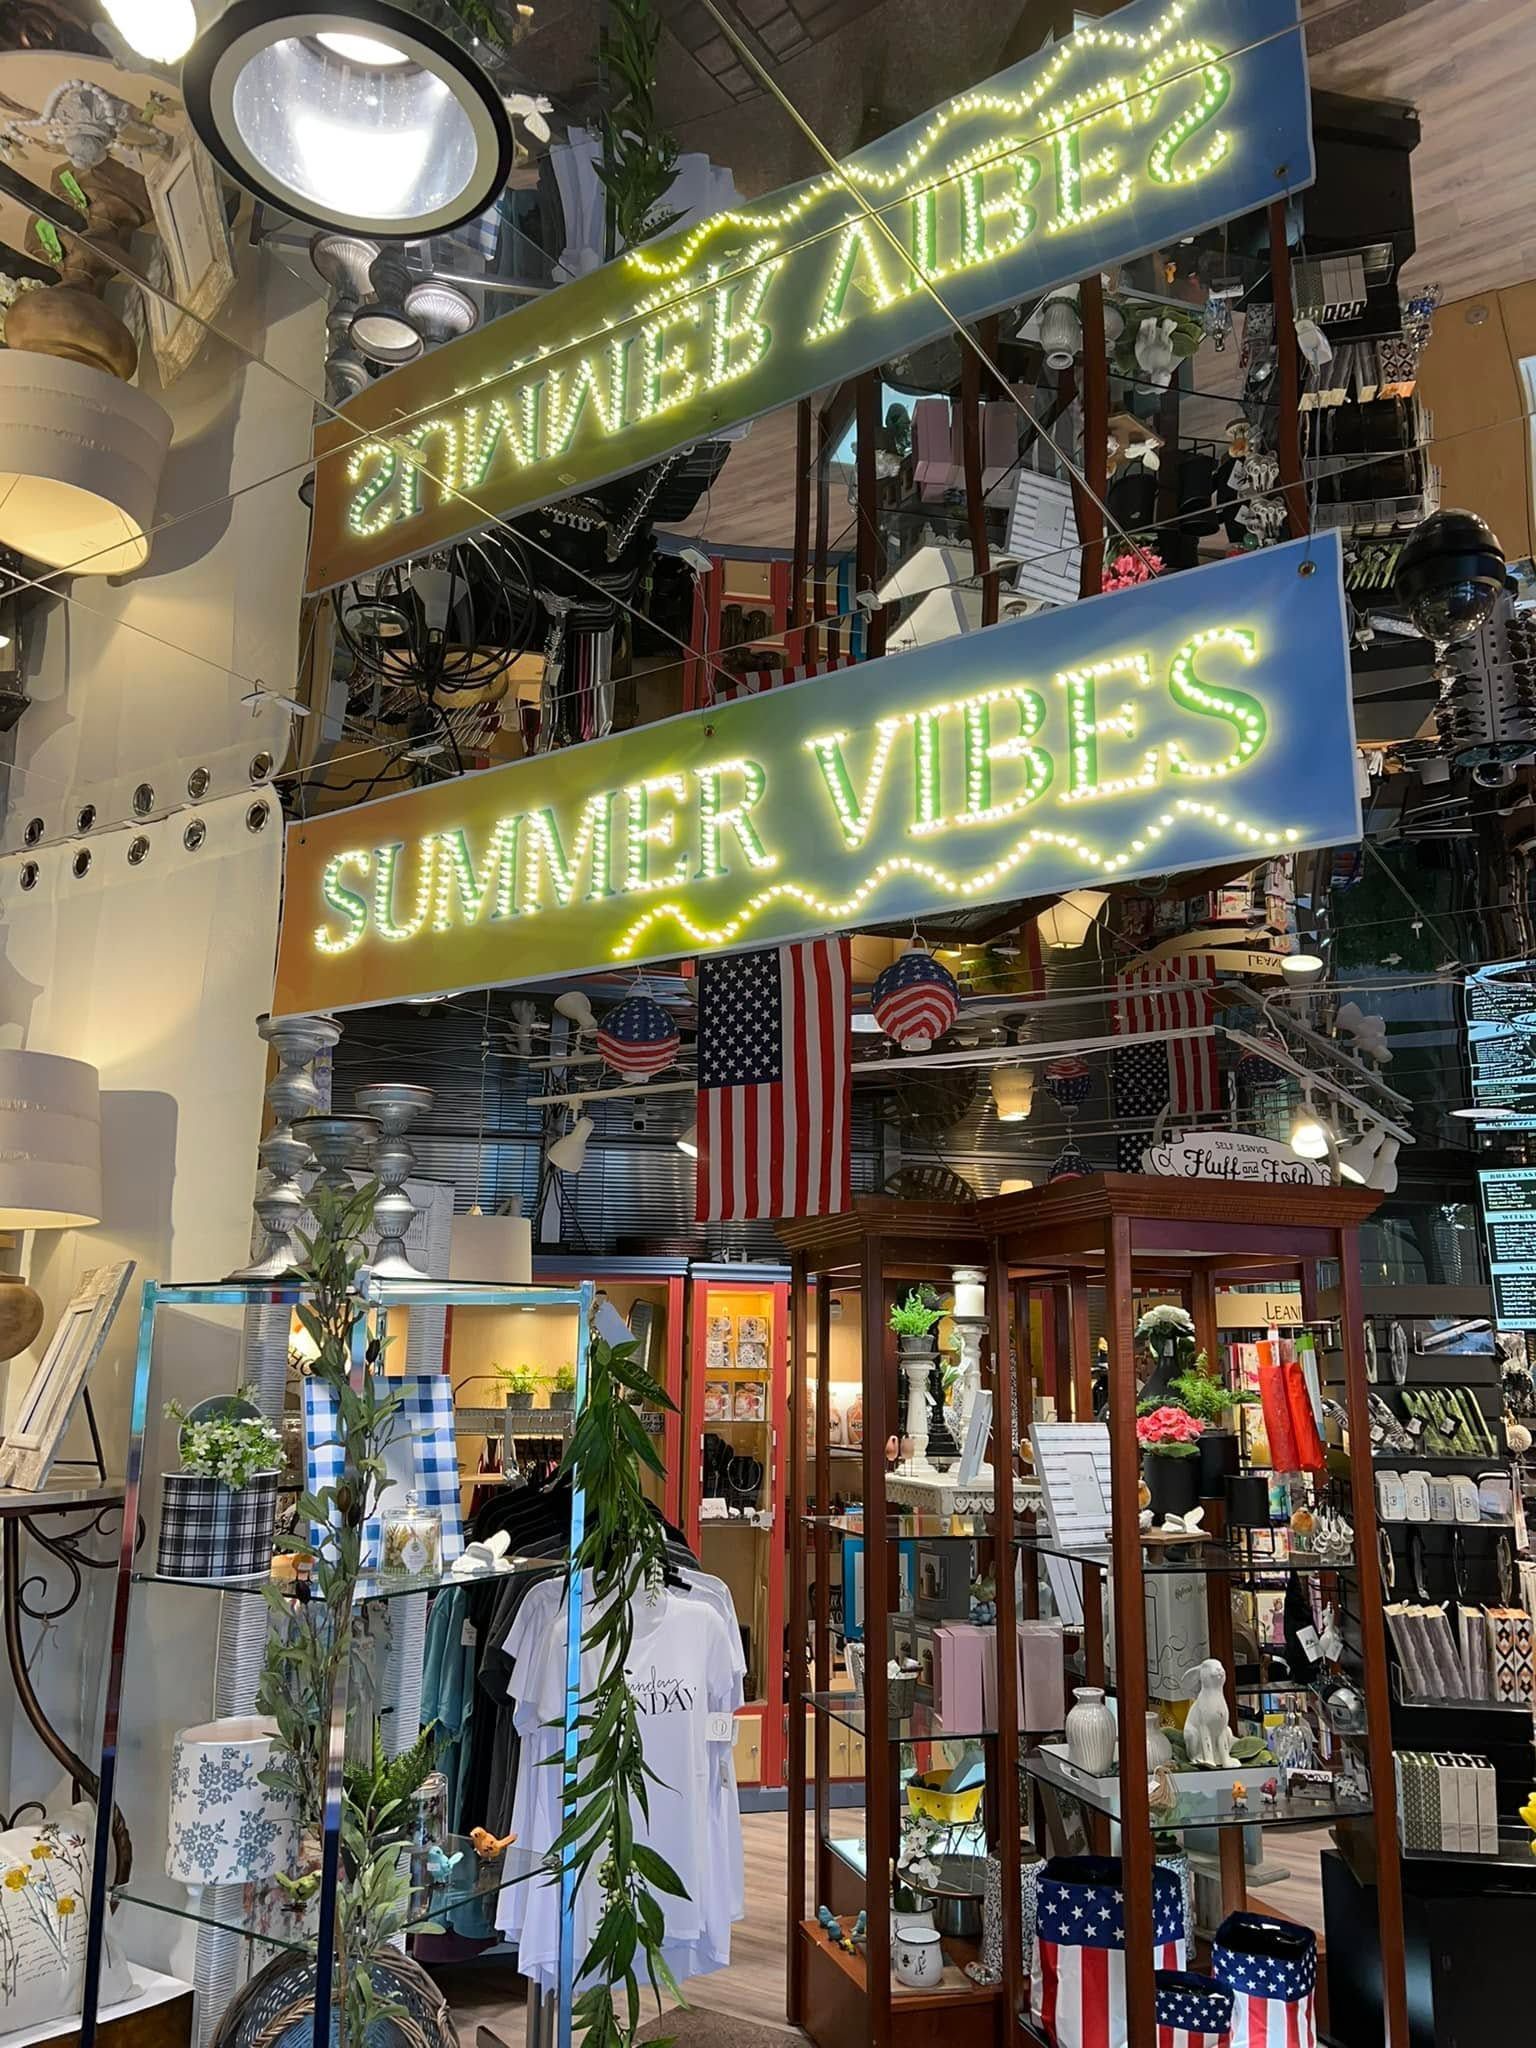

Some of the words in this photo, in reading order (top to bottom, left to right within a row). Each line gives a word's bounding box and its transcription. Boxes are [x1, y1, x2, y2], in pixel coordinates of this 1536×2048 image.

[312, 758, 779, 955] SUMMER
[804, 627, 1267, 848] VIBES
[1215, 1141, 1234, 1150] SELF
[1237, 1144, 1270, 1155] SERVICE
[1184, 1149, 1241, 1181] Fluff
[1242, 1162, 1259, 1177] and
[1261, 1158, 1313, 1186] Fold
[627, 1665, 686, 1705] unday
[635, 1686, 696, 1715] NDAY
